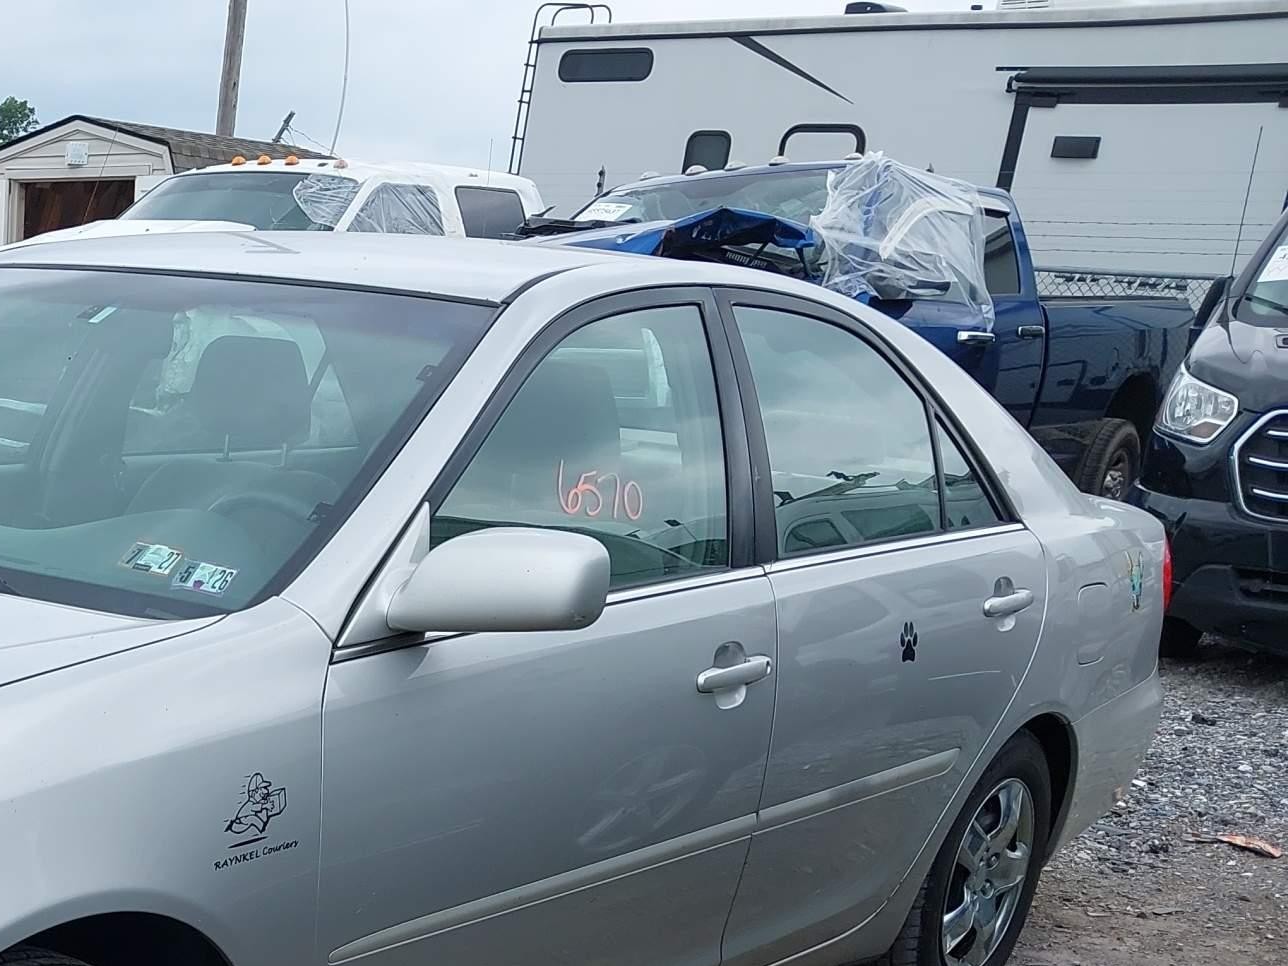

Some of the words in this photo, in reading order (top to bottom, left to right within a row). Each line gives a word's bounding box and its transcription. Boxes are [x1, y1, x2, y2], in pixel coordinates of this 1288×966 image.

[558, 458, 643, 520] 6570
[158, 551, 181, 572] 27
[211, 569, 234, 591] 26
[213, 849, 261, 871] RAYNKEL
[262, 839, 299, 856] Couriers
